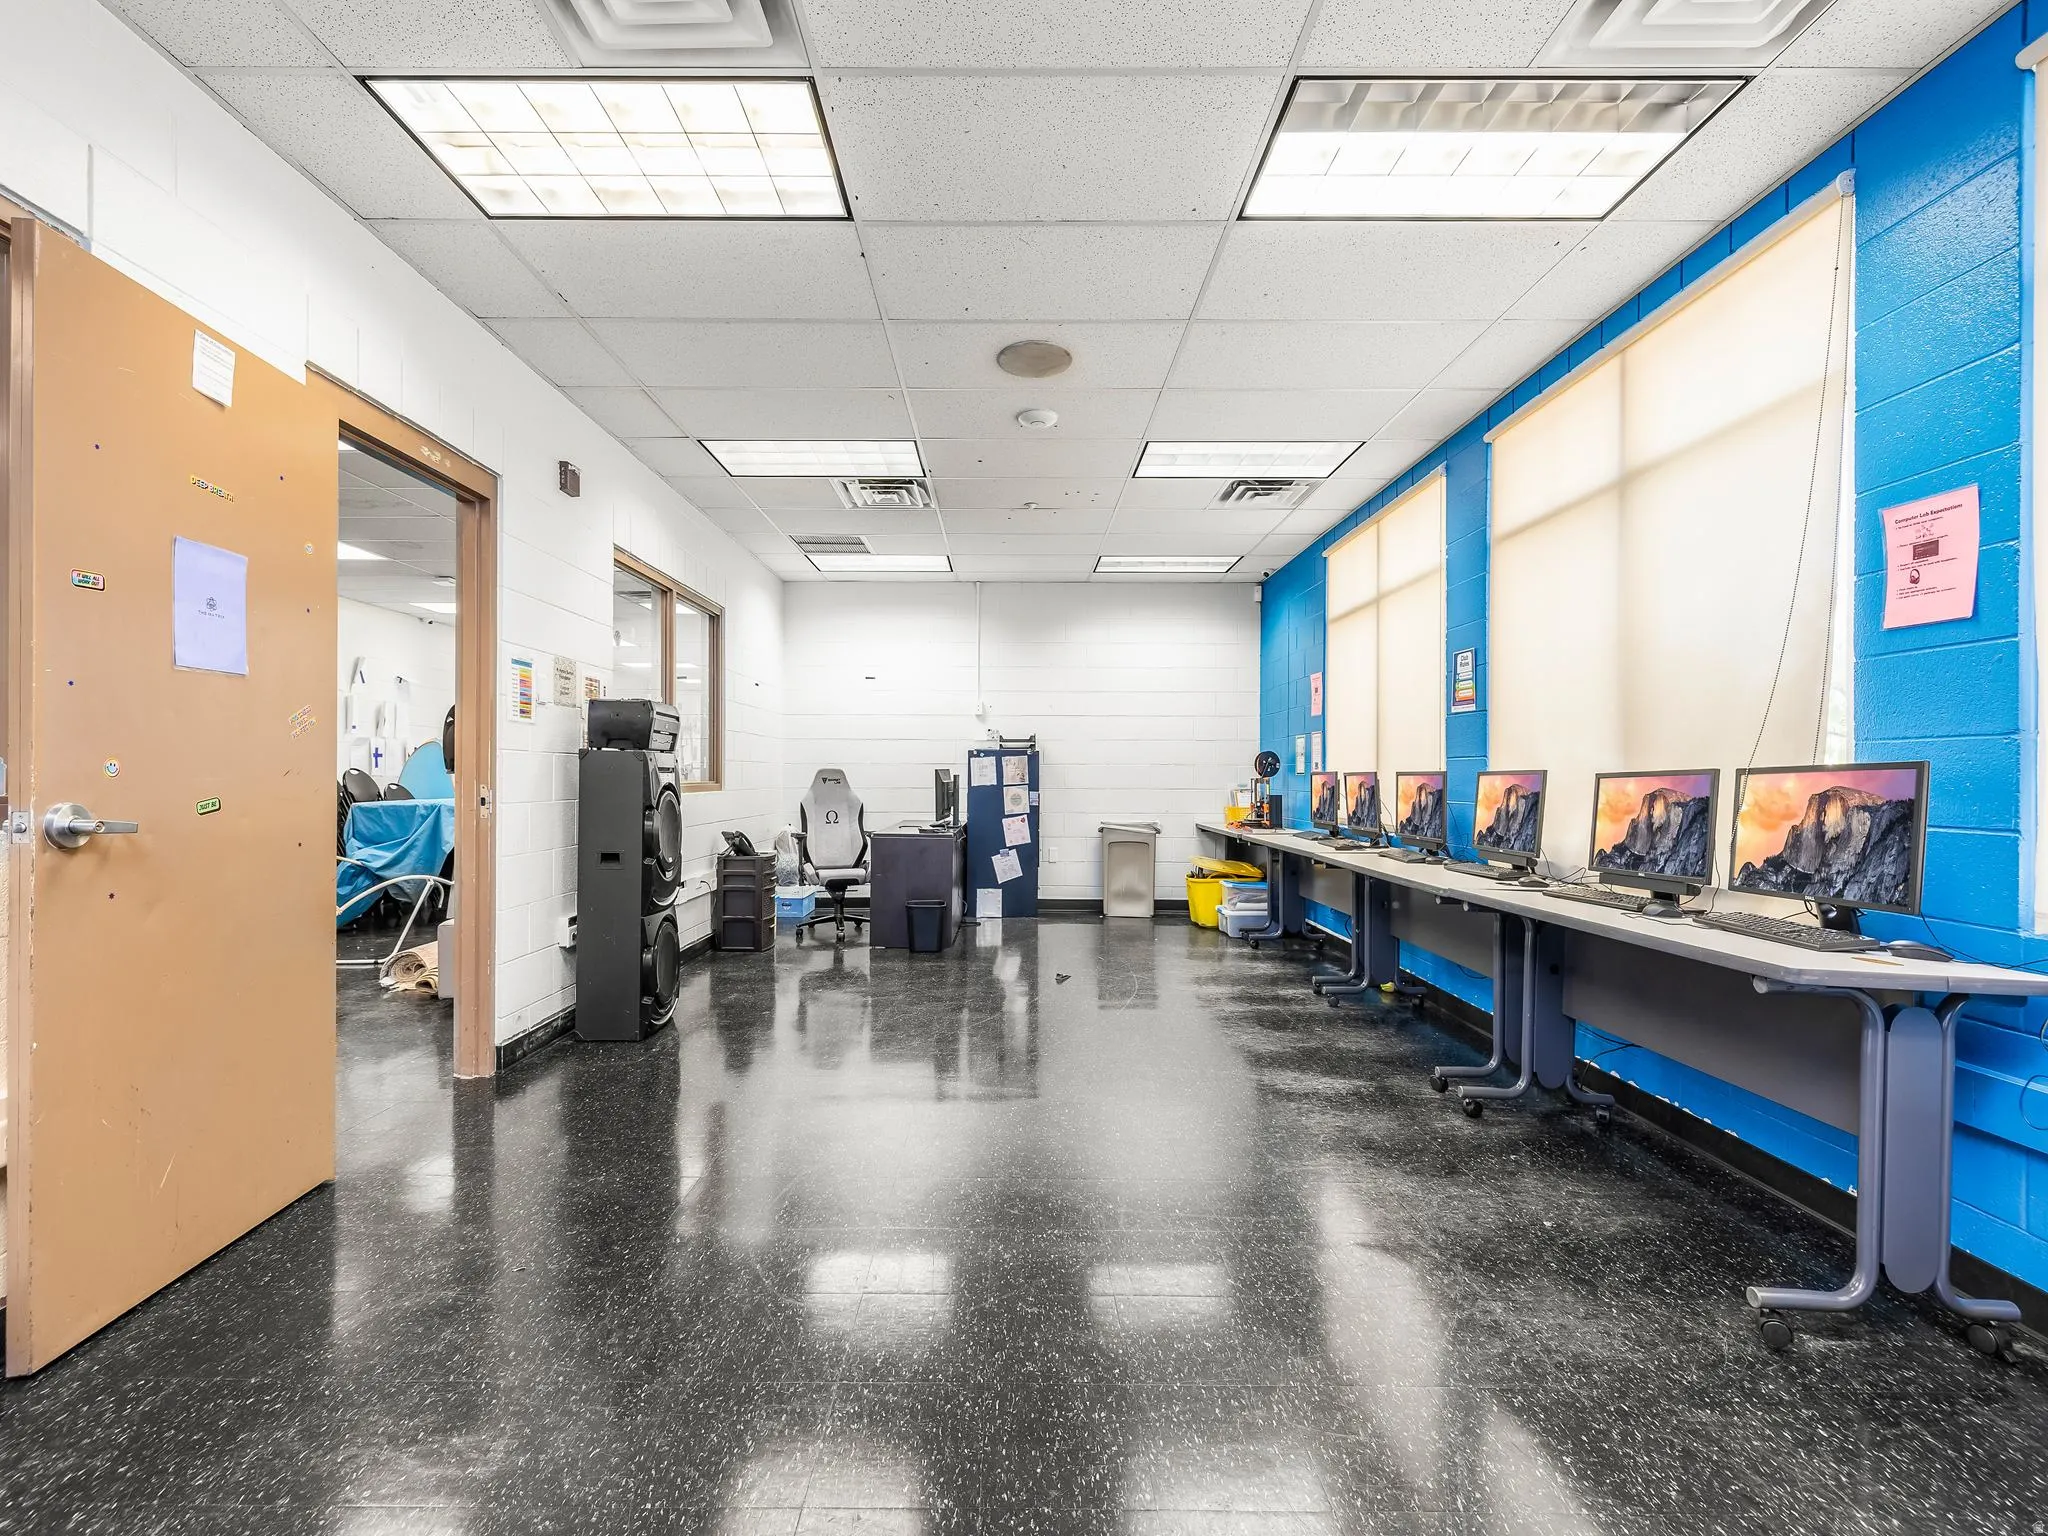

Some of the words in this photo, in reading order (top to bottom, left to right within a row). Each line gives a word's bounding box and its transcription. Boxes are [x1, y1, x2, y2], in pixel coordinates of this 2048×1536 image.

[191, 477, 208, 489] DEEP
[1894, 515, 1918, 524] Computer
[1930, 504, 1963, 515] Expectations
